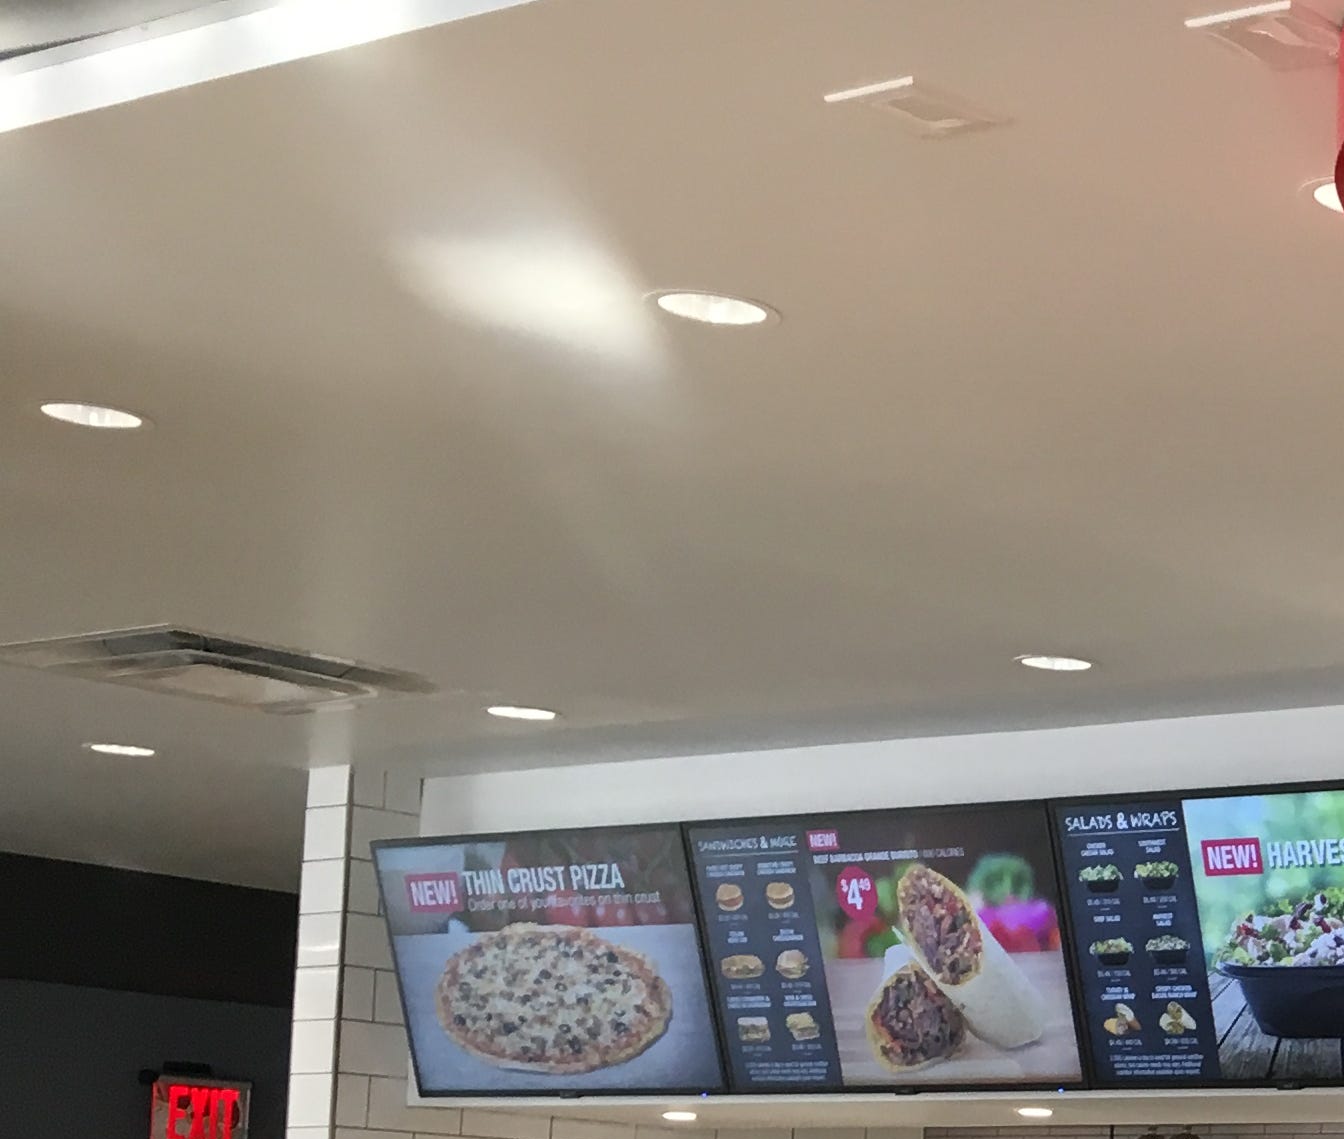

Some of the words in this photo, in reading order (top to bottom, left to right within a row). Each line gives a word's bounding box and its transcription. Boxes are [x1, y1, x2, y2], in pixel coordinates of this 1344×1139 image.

[1065, 814, 1113, 831] SALADS
[1117, 812, 1128, 830] &
[1130, 810, 1177, 828] WRAPS
[760, 836, 769, 849] &
[809, 833, 837, 848] NEW!
[1207, 844, 1258, 871] NEW!
[409, 879, 459, 907] NEW!
[463, 868, 504, 896] THIN
[507, 866, 565, 893] CRUST
[570, 863, 625, 891] PIZZA
